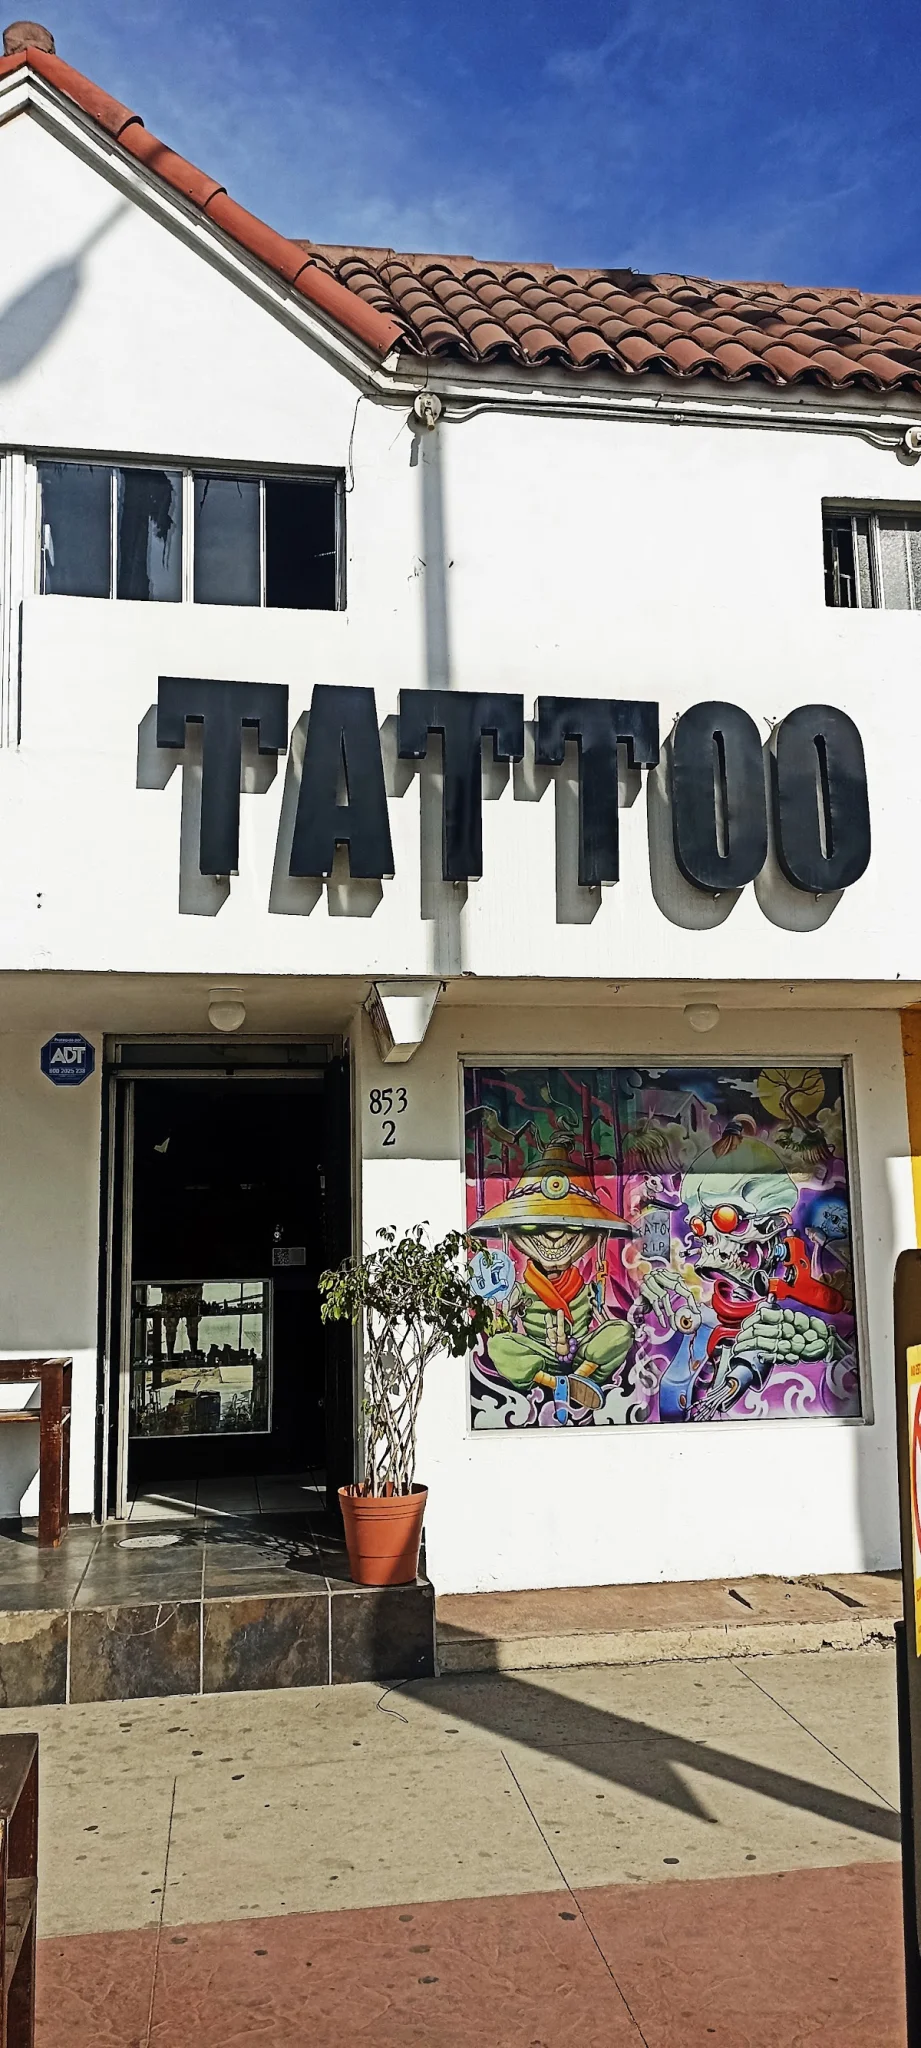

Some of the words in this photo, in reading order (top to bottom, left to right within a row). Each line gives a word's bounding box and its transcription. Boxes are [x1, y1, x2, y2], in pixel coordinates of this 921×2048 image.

[156, 676, 872, 893] TATTOO
[50, 1046, 86, 1064] ADT
[369, 1087, 408, 1116] 853
[382, 1120, 396, 1146] 2
